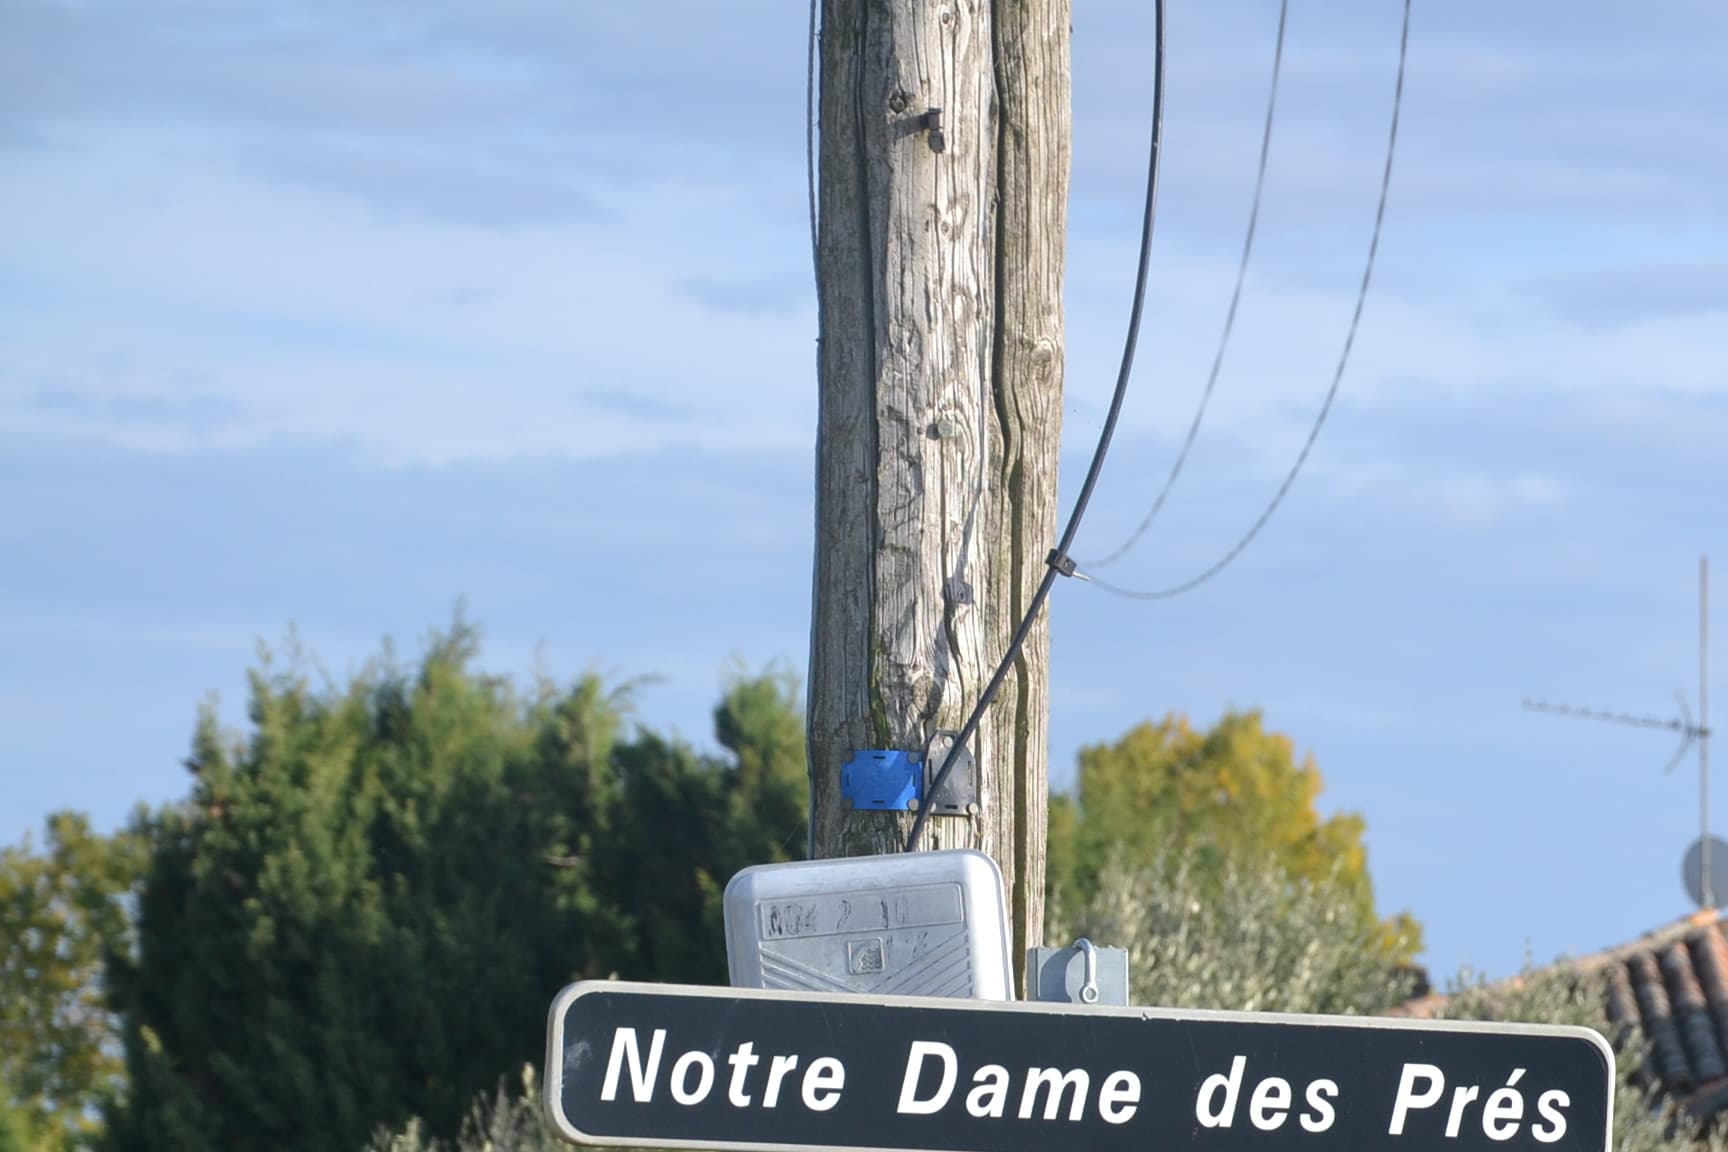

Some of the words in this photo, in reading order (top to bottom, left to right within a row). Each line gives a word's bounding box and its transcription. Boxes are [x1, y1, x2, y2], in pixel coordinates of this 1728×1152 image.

[600, 1027, 846, 1112] Notre
[896, 1040, 1142, 1124] Dame
[1195, 1055, 1339, 1133] des
[1388, 1062, 1571, 1143] Prés
